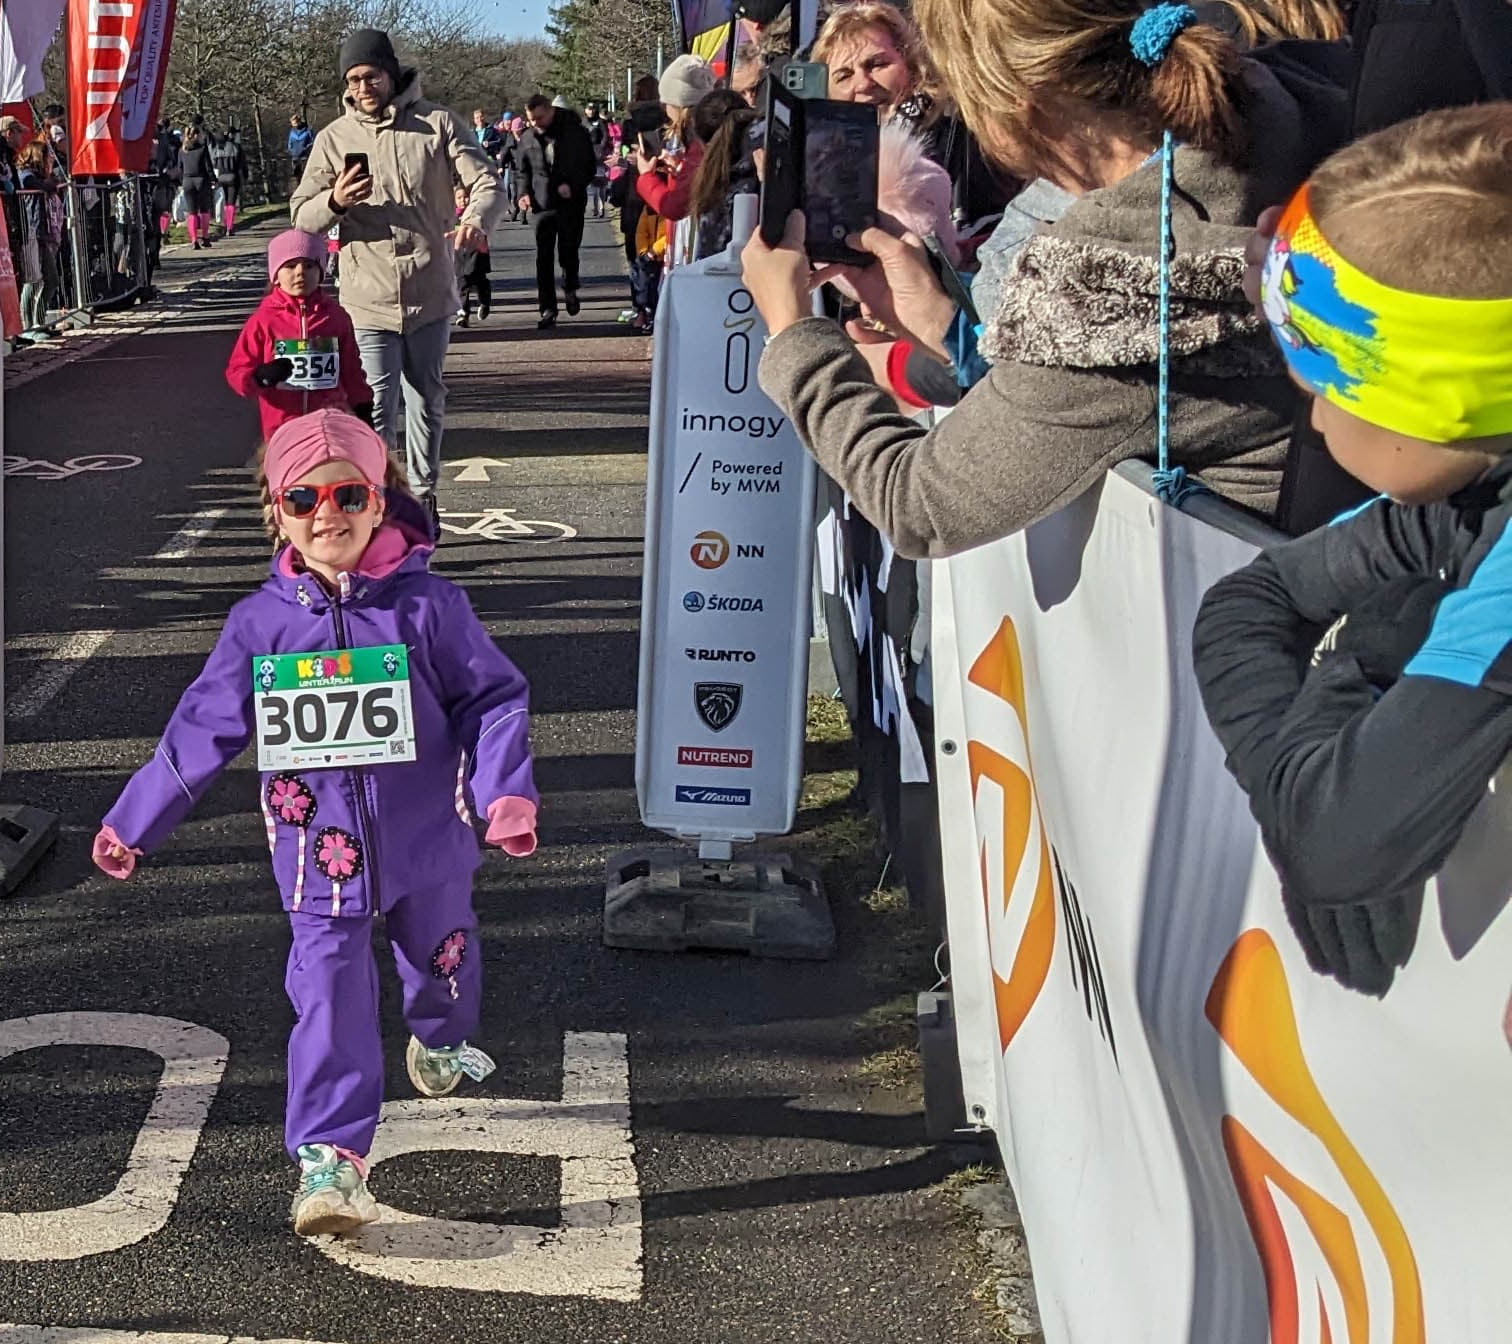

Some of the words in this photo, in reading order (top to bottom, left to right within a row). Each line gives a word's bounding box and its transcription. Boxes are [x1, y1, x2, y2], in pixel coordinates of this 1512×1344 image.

[144, 38, 158, 83] QUALITY
[139, 84, 150, 105] TOP
[293, 355, 337, 379] 354
[682, 408, 785, 438] innogy
[711, 460, 783, 476] Powered
[711, 479, 731, 494] by
[737, 479, 780, 493] MVM
[736, 544, 765, 558] NN
[707, 594, 764, 612] ŠKODA
[698, 650, 756, 663] RUNTO
[261, 687, 399, 746] 3076
[681, 750, 749, 764] NUTREND
